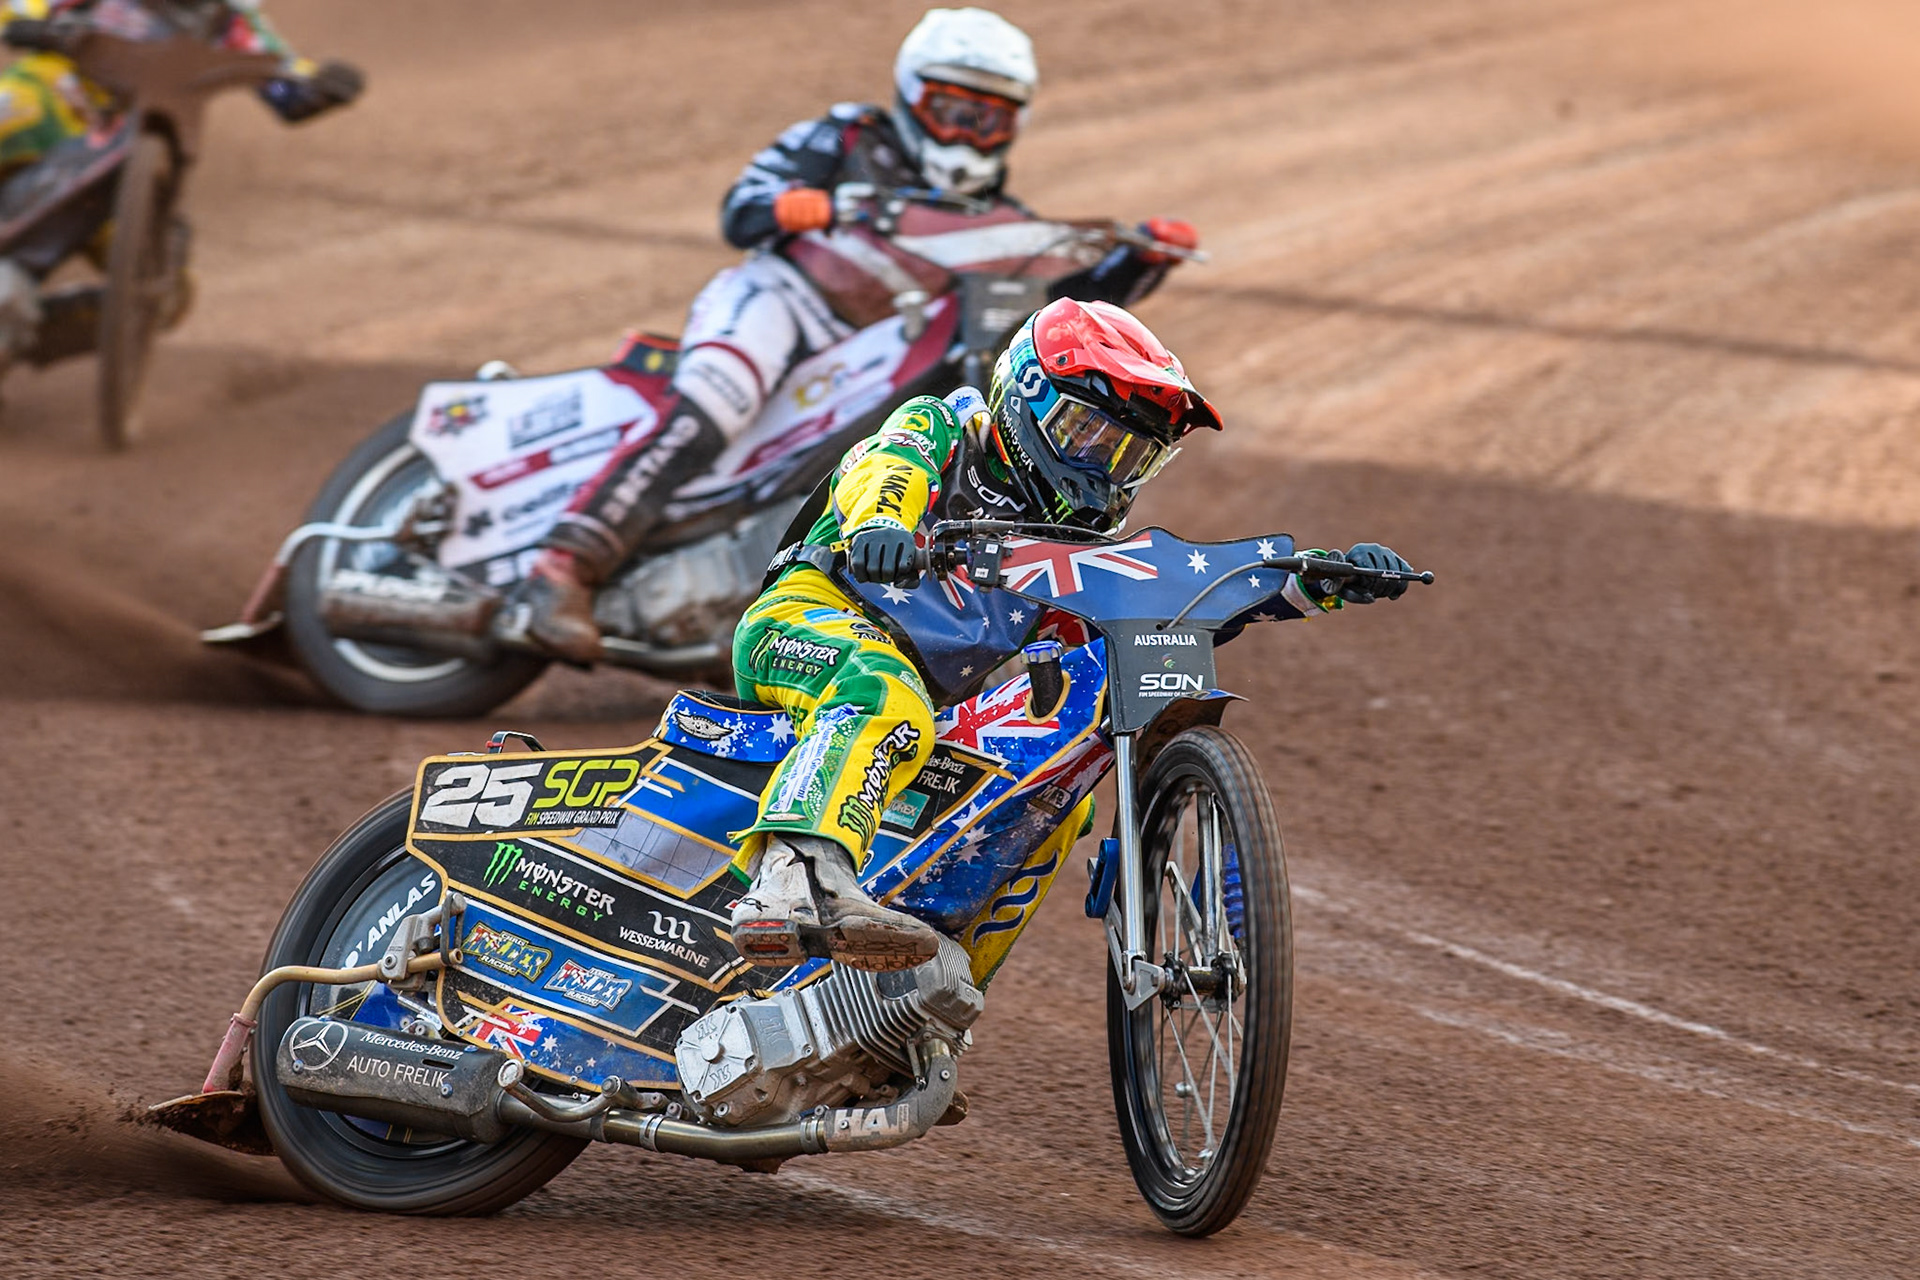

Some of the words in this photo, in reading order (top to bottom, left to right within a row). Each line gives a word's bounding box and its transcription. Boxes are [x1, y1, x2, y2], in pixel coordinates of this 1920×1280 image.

[1134, 634, 1198, 646] AUSTRALIA
[773, 657, 822, 676] ENERGY
[1139, 673, 1204, 691] SON
[420, 763, 544, 828] 25
[532, 759, 640, 808] SGP
[524, 812, 539, 825] FIM
[537, 811, 577, 825] SPEEDWAY
[573, 811, 600, 824] GRAND
[600, 811, 620, 824] PRIX
[367, 872, 437, 952] ANLAS
[518, 880, 603, 921] ENERGY
[619, 926, 710, 968] WESSEXMARINE
[481, 955, 517, 973] RACING
[360, 1031, 464, 1060] Mercedes-Benz
[347, 1055, 391, 1078] AUTO
[393, 1064, 450, 1088] FRELIK
